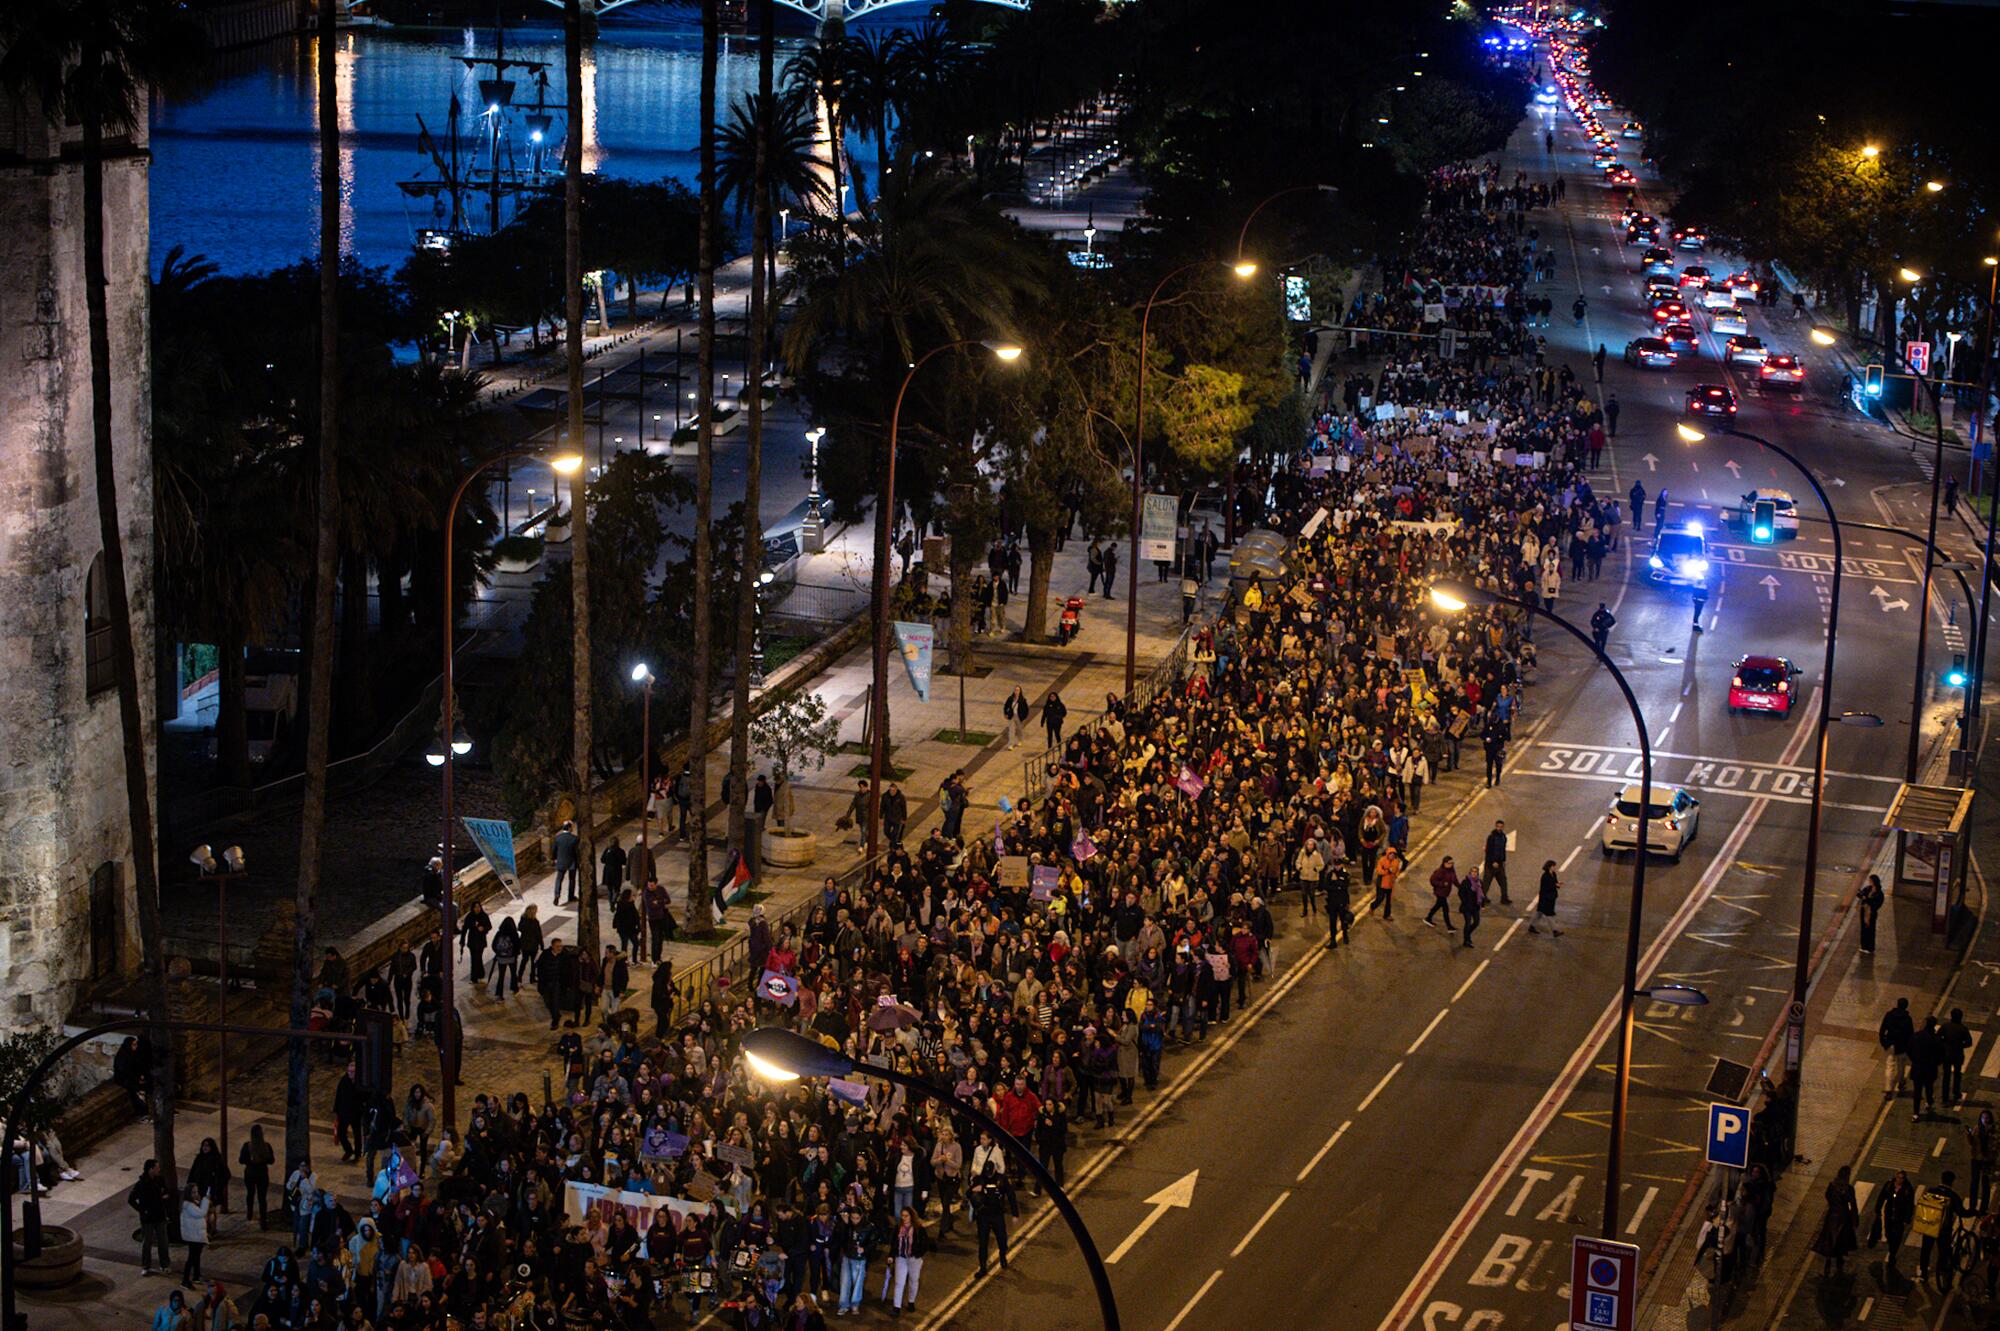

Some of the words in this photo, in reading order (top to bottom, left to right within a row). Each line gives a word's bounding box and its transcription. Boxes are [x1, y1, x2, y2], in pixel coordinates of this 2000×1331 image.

[1777, 552, 1885, 576] MOTOS
[1540, 749, 1656, 778] SOLO
[1685, 761, 1829, 797] MOTOS
[1716, 1112, 1742, 1143] P
[1504, 1168, 1659, 1234] TAI
